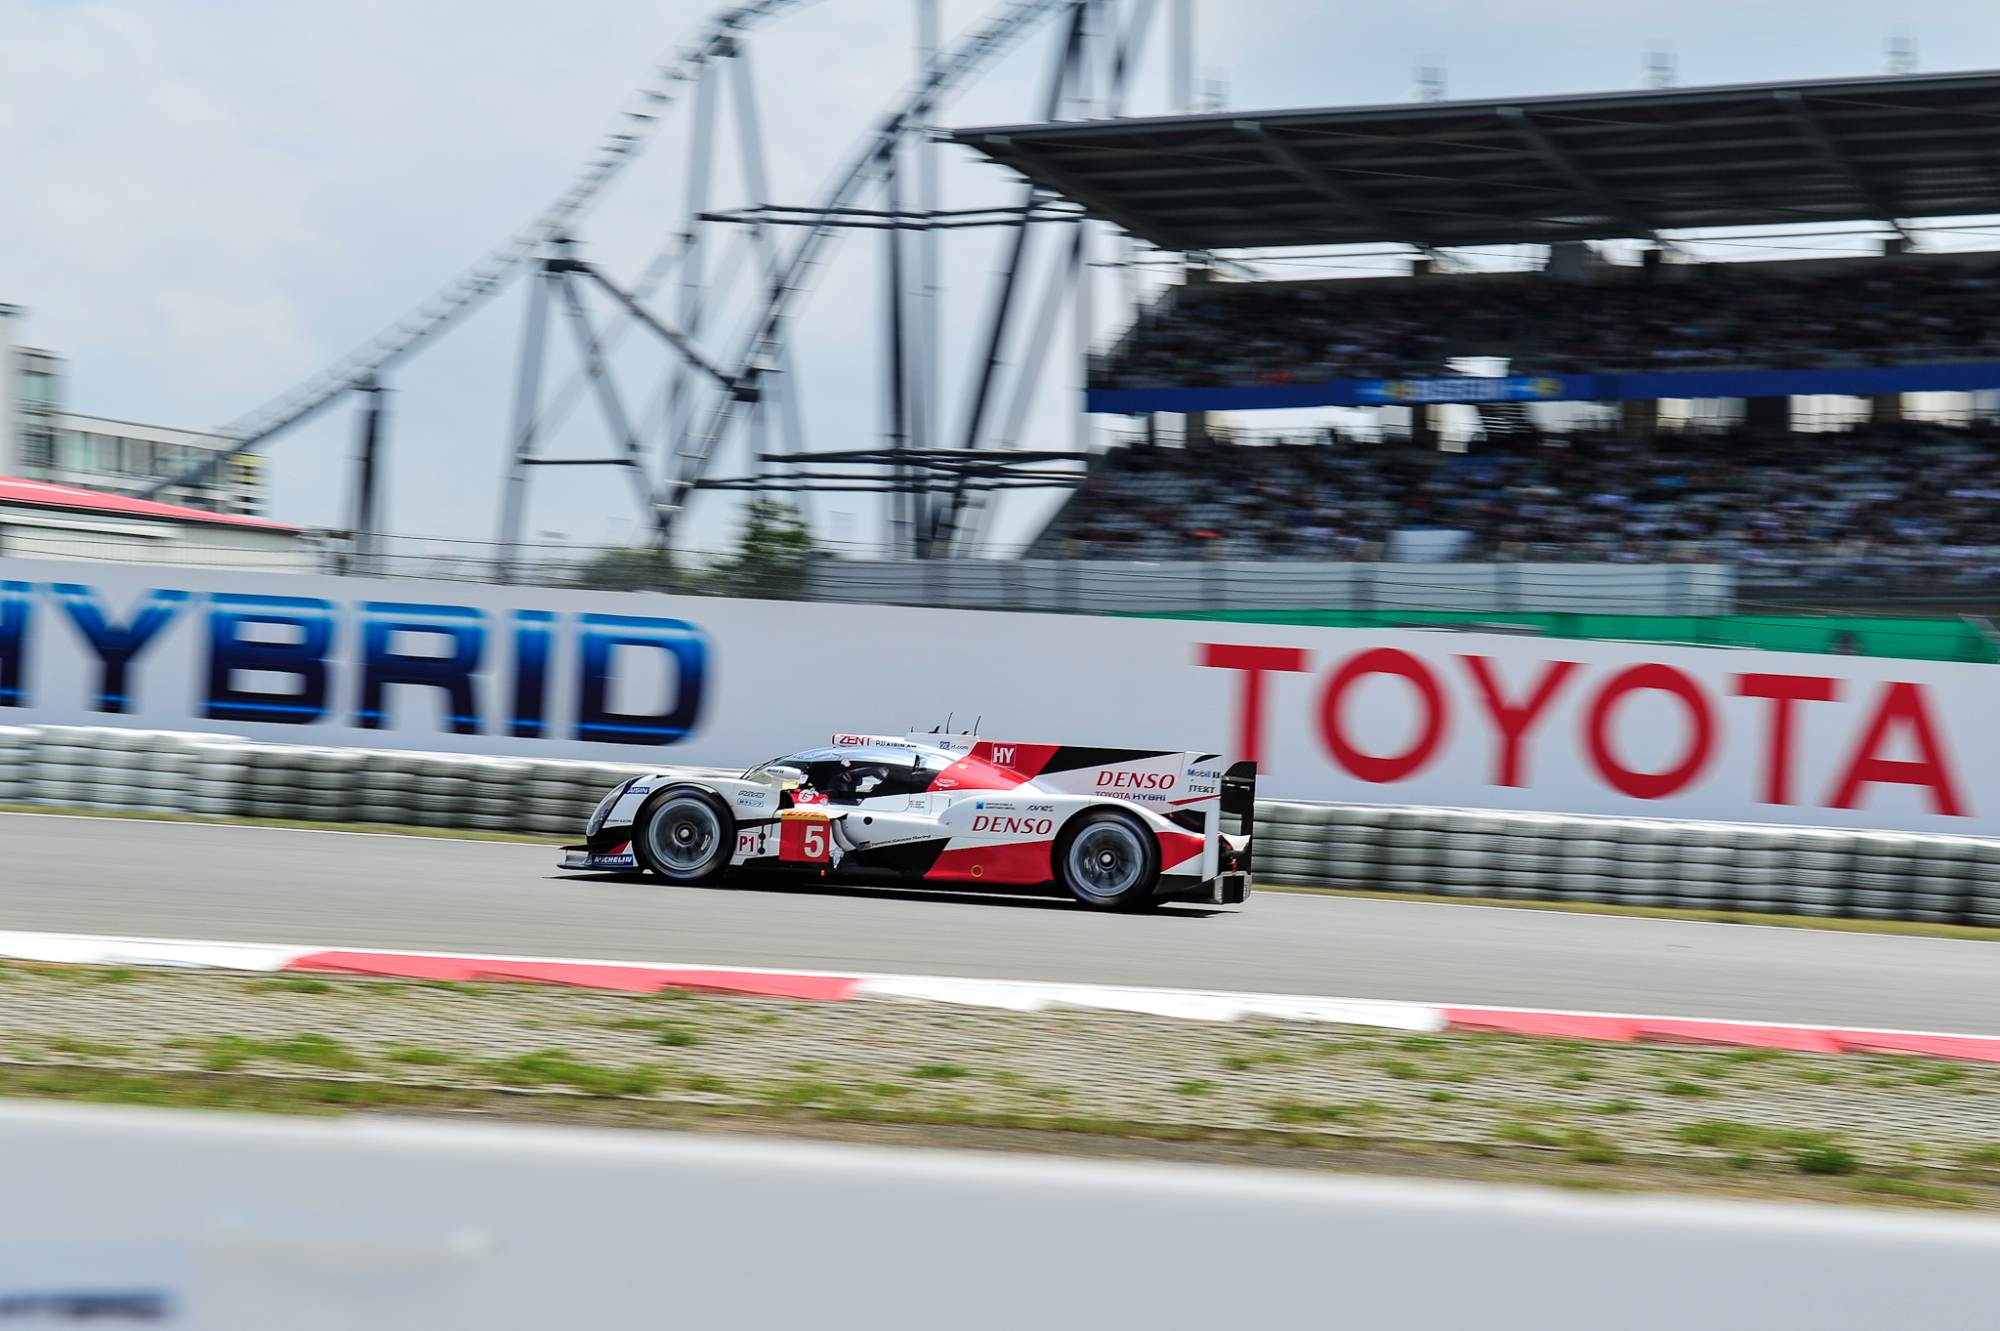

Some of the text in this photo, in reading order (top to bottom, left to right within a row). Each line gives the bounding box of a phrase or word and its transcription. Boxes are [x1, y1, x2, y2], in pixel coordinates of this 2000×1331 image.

[0, 580, 714, 746] YBRID
[1195, 643, 1972, 816] TOYOTA
[840, 735, 872, 746] ZENT
[992, 746, 1015, 764] HY
[1096, 770, 1175, 790] DENSO
[1187, 769, 1211, 778] Mobil
[971, 815, 1053, 834] DENSO
[739, 835, 754, 853] P1
[803, 825, 825, 858] 5
